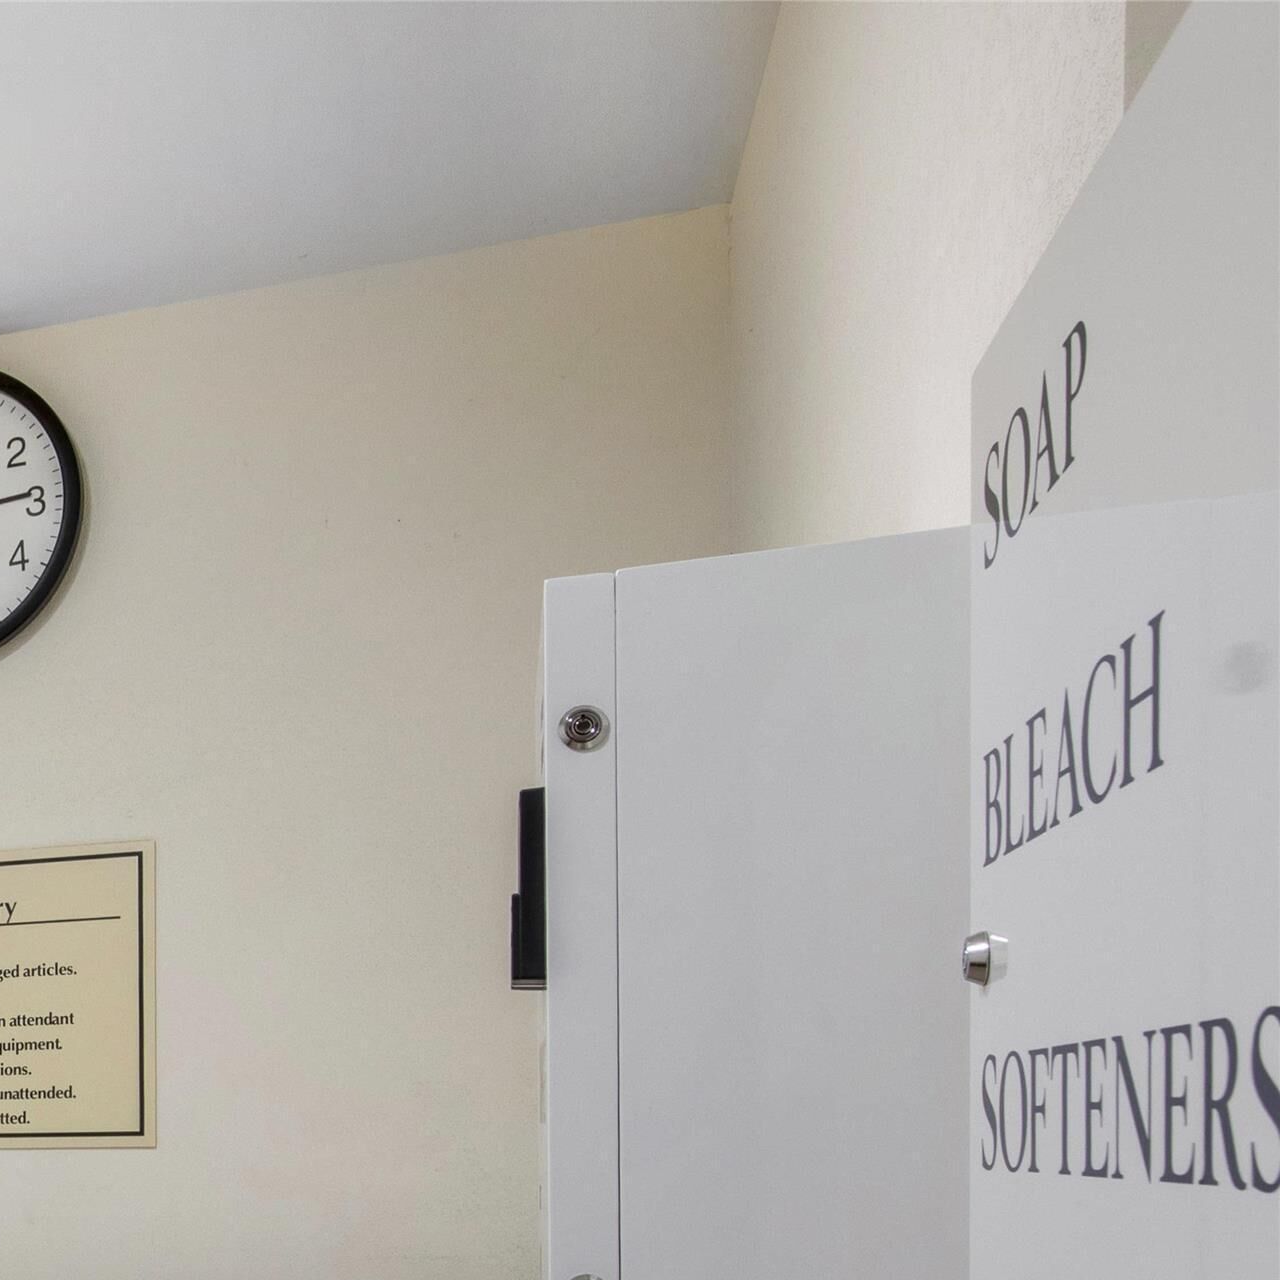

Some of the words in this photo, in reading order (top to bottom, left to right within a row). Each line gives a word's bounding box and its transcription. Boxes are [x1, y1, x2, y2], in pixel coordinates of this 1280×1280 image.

[6, 436, 27, 468] 2
[983, 320, 1088, 570] SOAP
[25, 485, 46, 517] 3
[8, 539, 29, 571] 4
[982, 609, 1166, 868] BLEACH
[23, 962, 77, 977] articles.
[9, 1012, 74, 1027] attendant
[981, 1005, 1280, 1194] SOFTENERS
